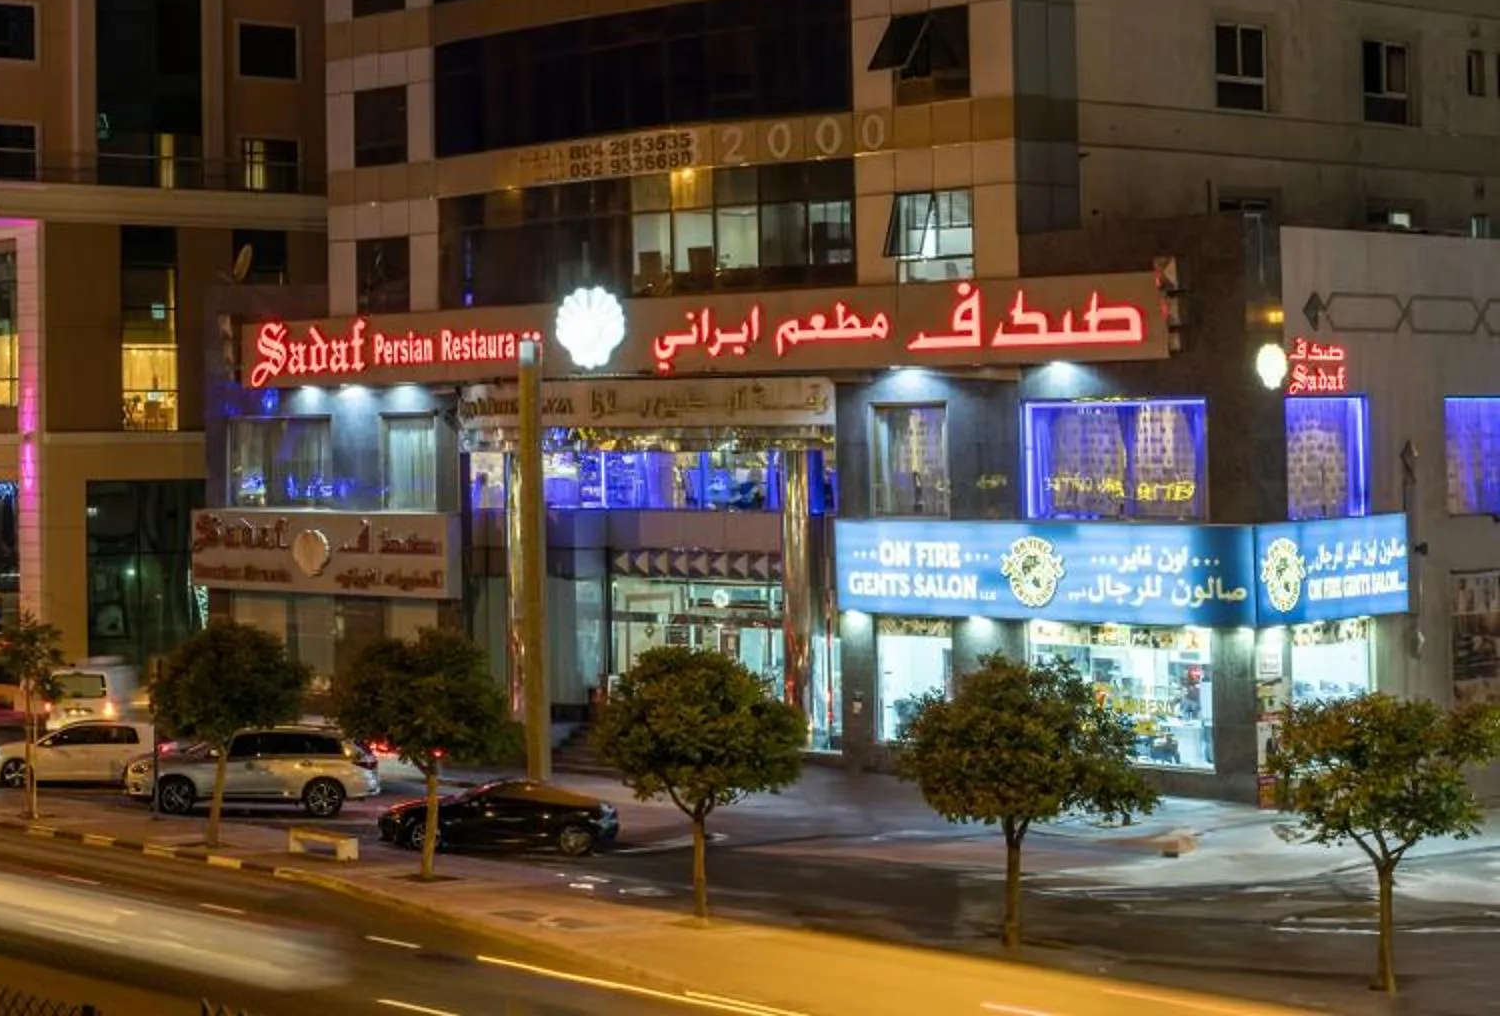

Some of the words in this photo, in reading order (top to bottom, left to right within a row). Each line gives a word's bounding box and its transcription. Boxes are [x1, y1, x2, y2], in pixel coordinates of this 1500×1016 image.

[775, 302, 891, 354] مطعم
[251, 317, 368, 387] Sadaf
[374, 333, 433, 365] Persian
[441, 329, 542, 363] Restaura
[1288, 364, 1346, 395] Sadaf
[879, 540, 911, 566] ON
[915, 541, 961, 569] FIRE
[848, 571, 910, 597] GENTS
[913, 572, 978, 600] SALON
[1170, 576, 1248, 608] صالون
